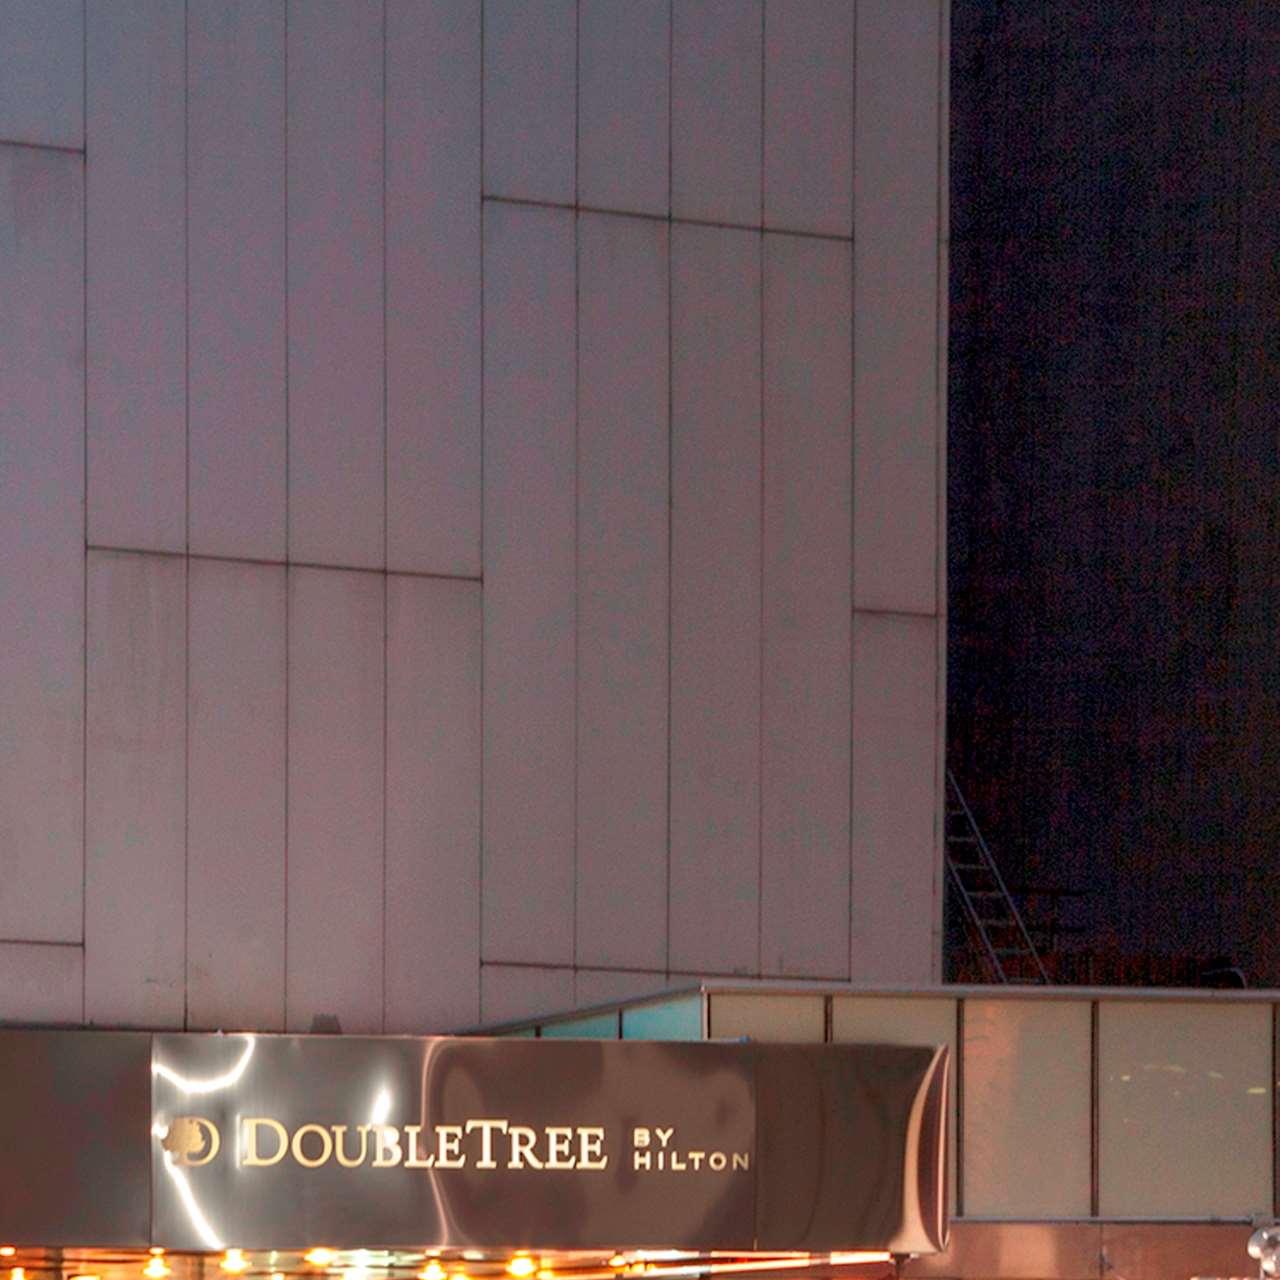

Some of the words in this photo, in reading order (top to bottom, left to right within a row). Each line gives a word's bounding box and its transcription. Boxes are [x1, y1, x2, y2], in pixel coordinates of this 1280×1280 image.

[241, 1117, 607, 1170] DOUBLETREE
[633, 1129, 674, 1147] BY
[633, 1152, 751, 1172] HILTON
